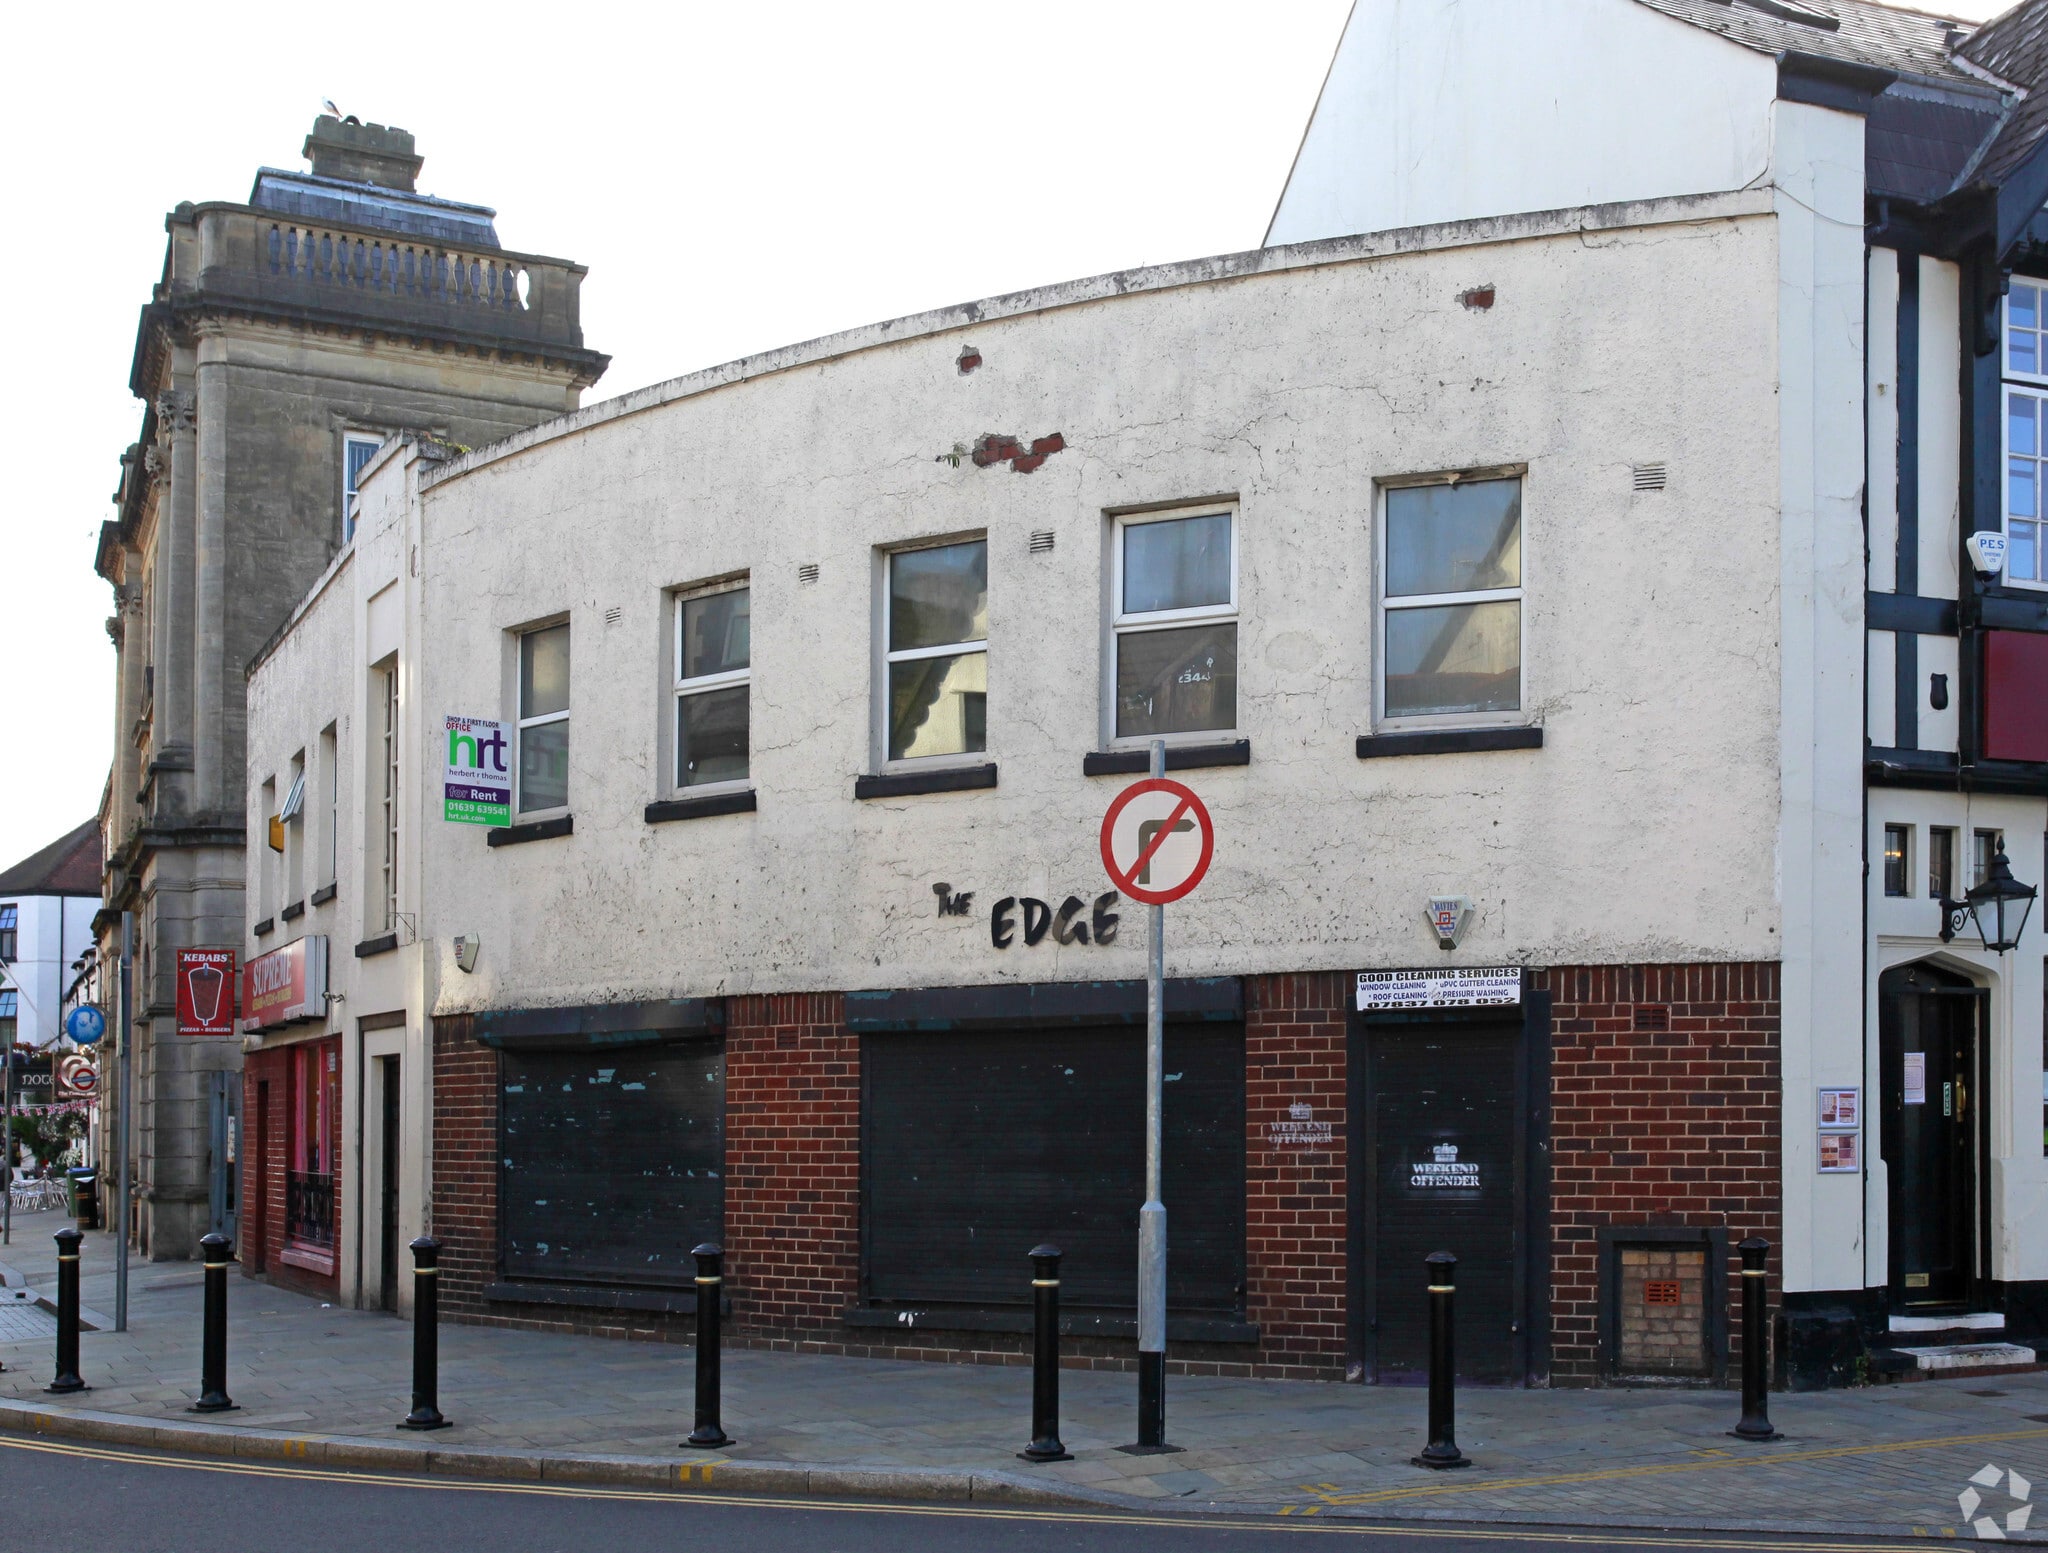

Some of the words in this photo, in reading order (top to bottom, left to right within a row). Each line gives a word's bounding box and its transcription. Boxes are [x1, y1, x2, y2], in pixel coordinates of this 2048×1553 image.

[446, 722, 471, 732] OFFICE
[447, 715, 461, 723] SHOP
[467, 719, 482, 727] FIRST
[482, 720, 499, 729] FLOOR
[449, 729, 507, 772] hrt
[448, 769, 475, 778] herbert
[481, 772, 507, 782] thomas
[449, 785, 468, 799] for
[471, 789, 497, 802] Rent
[448, 802, 475, 813] 01639
[477, 805, 507, 816] 639541
[448, 812, 486, 823] hrt.uk.com
[991, 890, 1119, 949] EDGE
[183, 953, 228, 962] KEBABS
[253, 949, 292, 998] SUPREME
[1359, 973, 1393, 982] GOOD
[1396, 970, 1456, 981] CLEANING
[1458, 968, 1519, 979] SERVICES
[1908, 968, 1915, 981] 2
[1392, 981, 1427, 990] CLEANING
[1440, 980, 1458, 988] uPVC
[1459, 979, 1485, 988] GUTTER
[1486, 978, 1520, 987] CLEANING
[1373, 992, 1392, 1000] ROOF
[1393, 991, 1428, 1000] CLEANING
[1442, 989, 1475, 999] PRESSURE
[1476, 989, 1509, 997] WASHING
[1270, 1122, 1332, 1132] WEEKEND
[1268, 1133, 1333, 1144] OFFENDER
[1412, 1163, 1479, 1174] WEEKEND
[1410, 1175, 1480, 1187] OFFENDER
